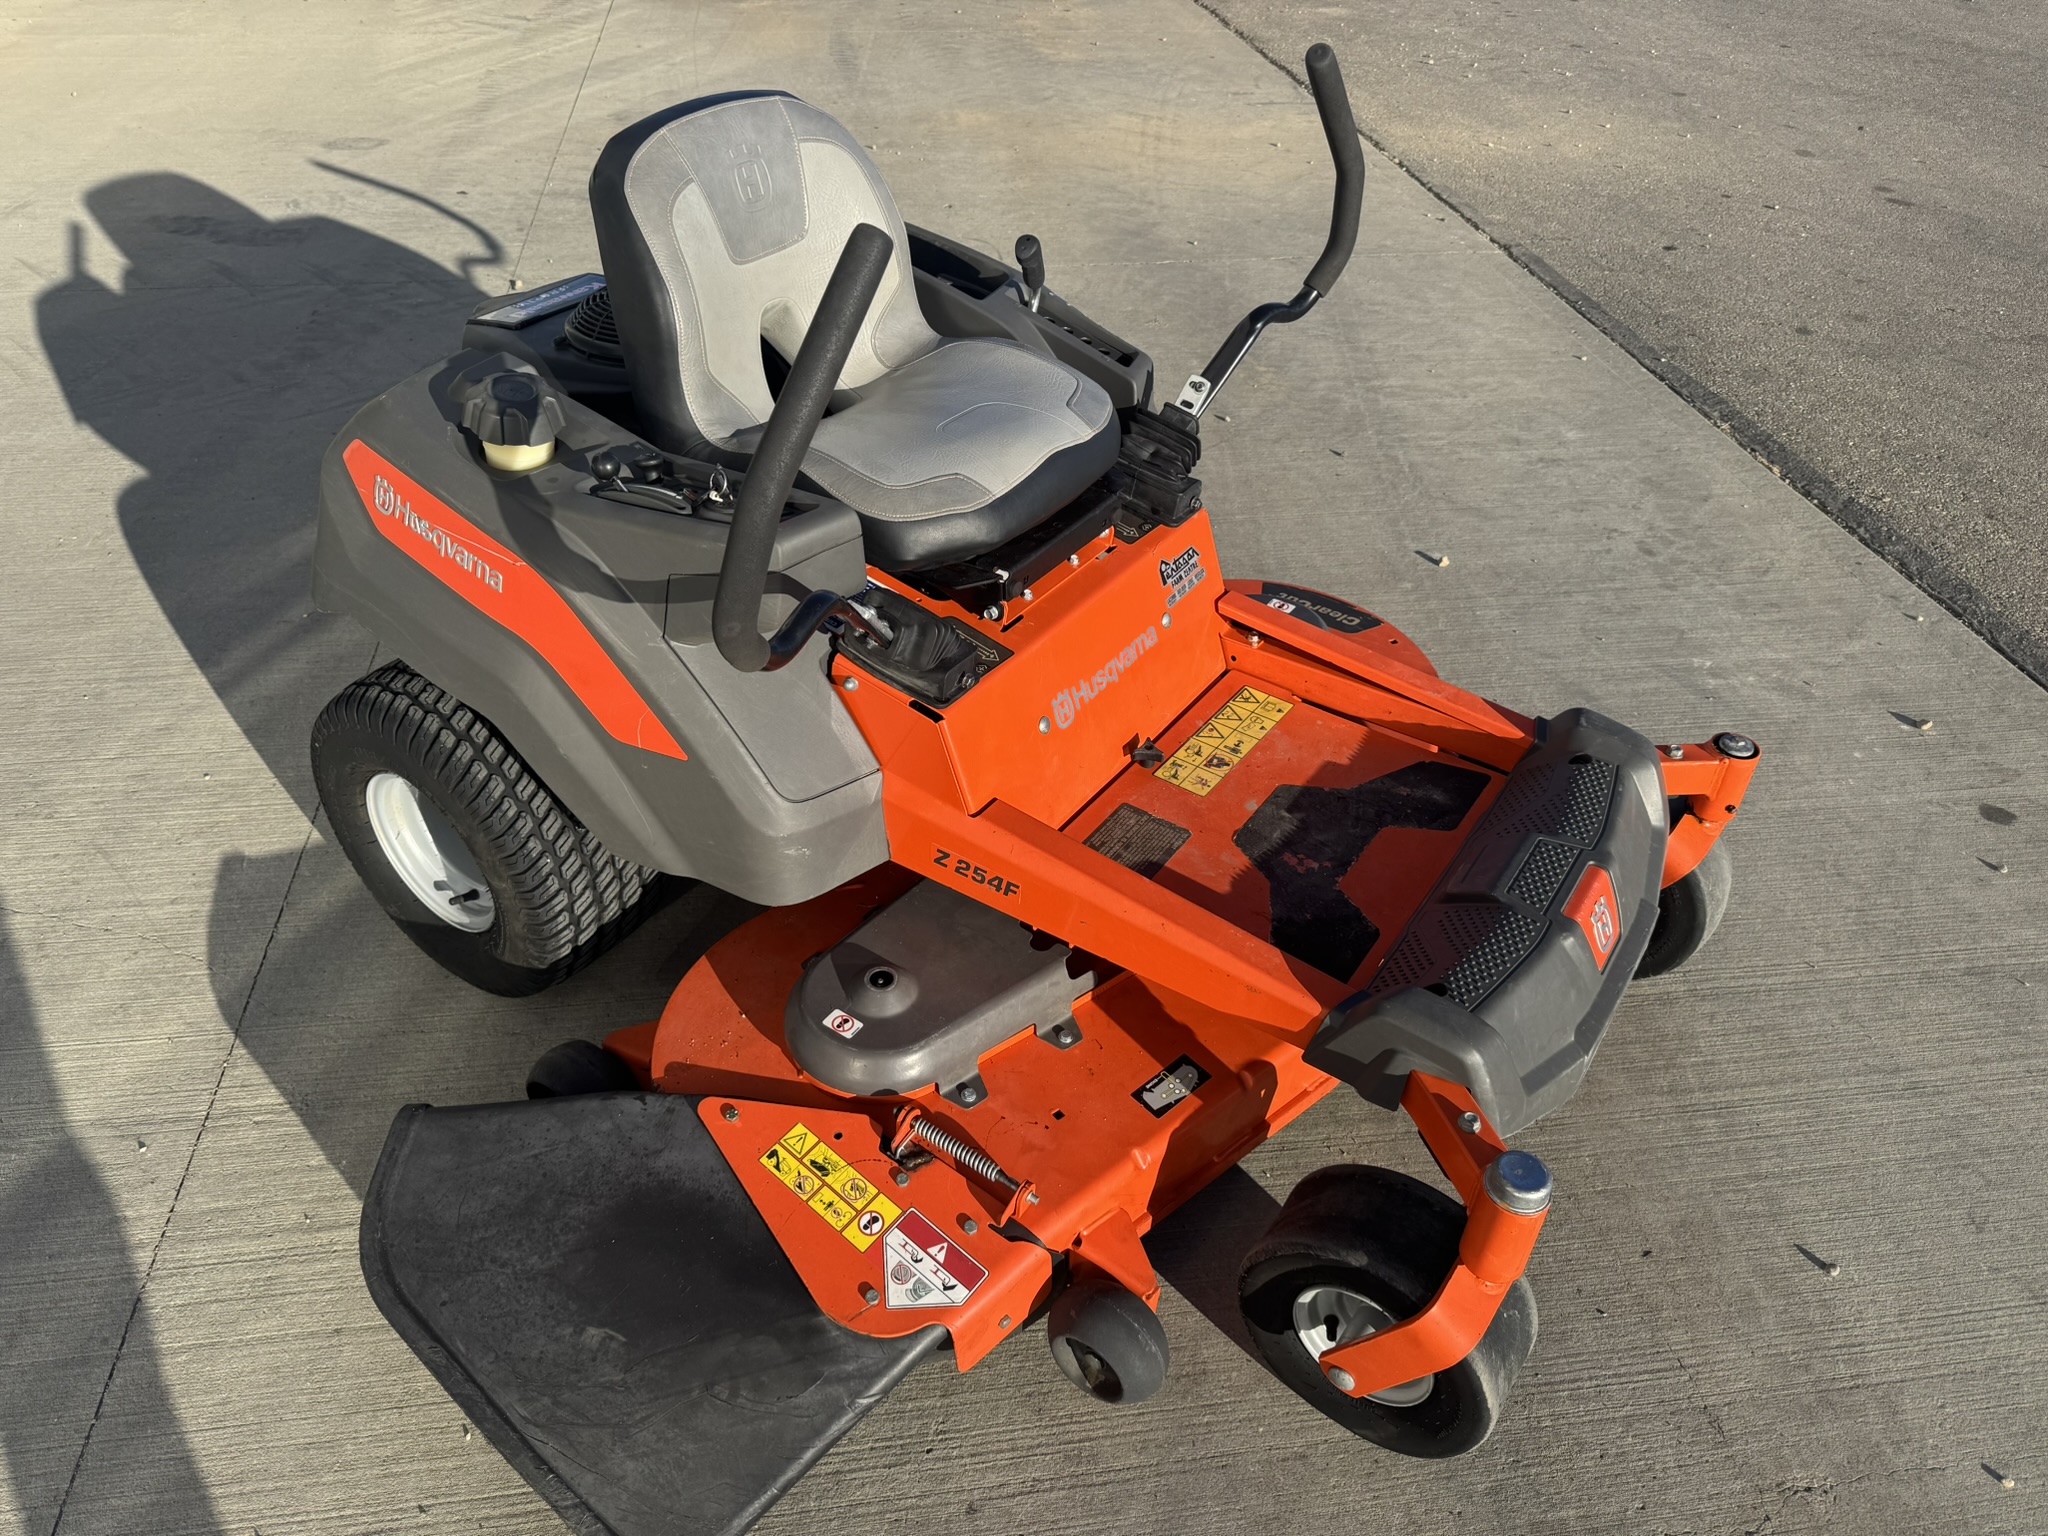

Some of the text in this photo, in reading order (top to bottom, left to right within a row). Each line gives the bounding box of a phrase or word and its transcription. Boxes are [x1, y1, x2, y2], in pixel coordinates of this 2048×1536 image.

[395, 494, 503, 593] Husqvarna
[1160, 547, 1199, 586] Pentagon
[1171, 574, 1184, 589] FARM
[1184, 561, 1199, 578] CENTRE
[1072, 626, 1158, 711] Husqvarna
[933, 849, 1020, 897] Z 254F
